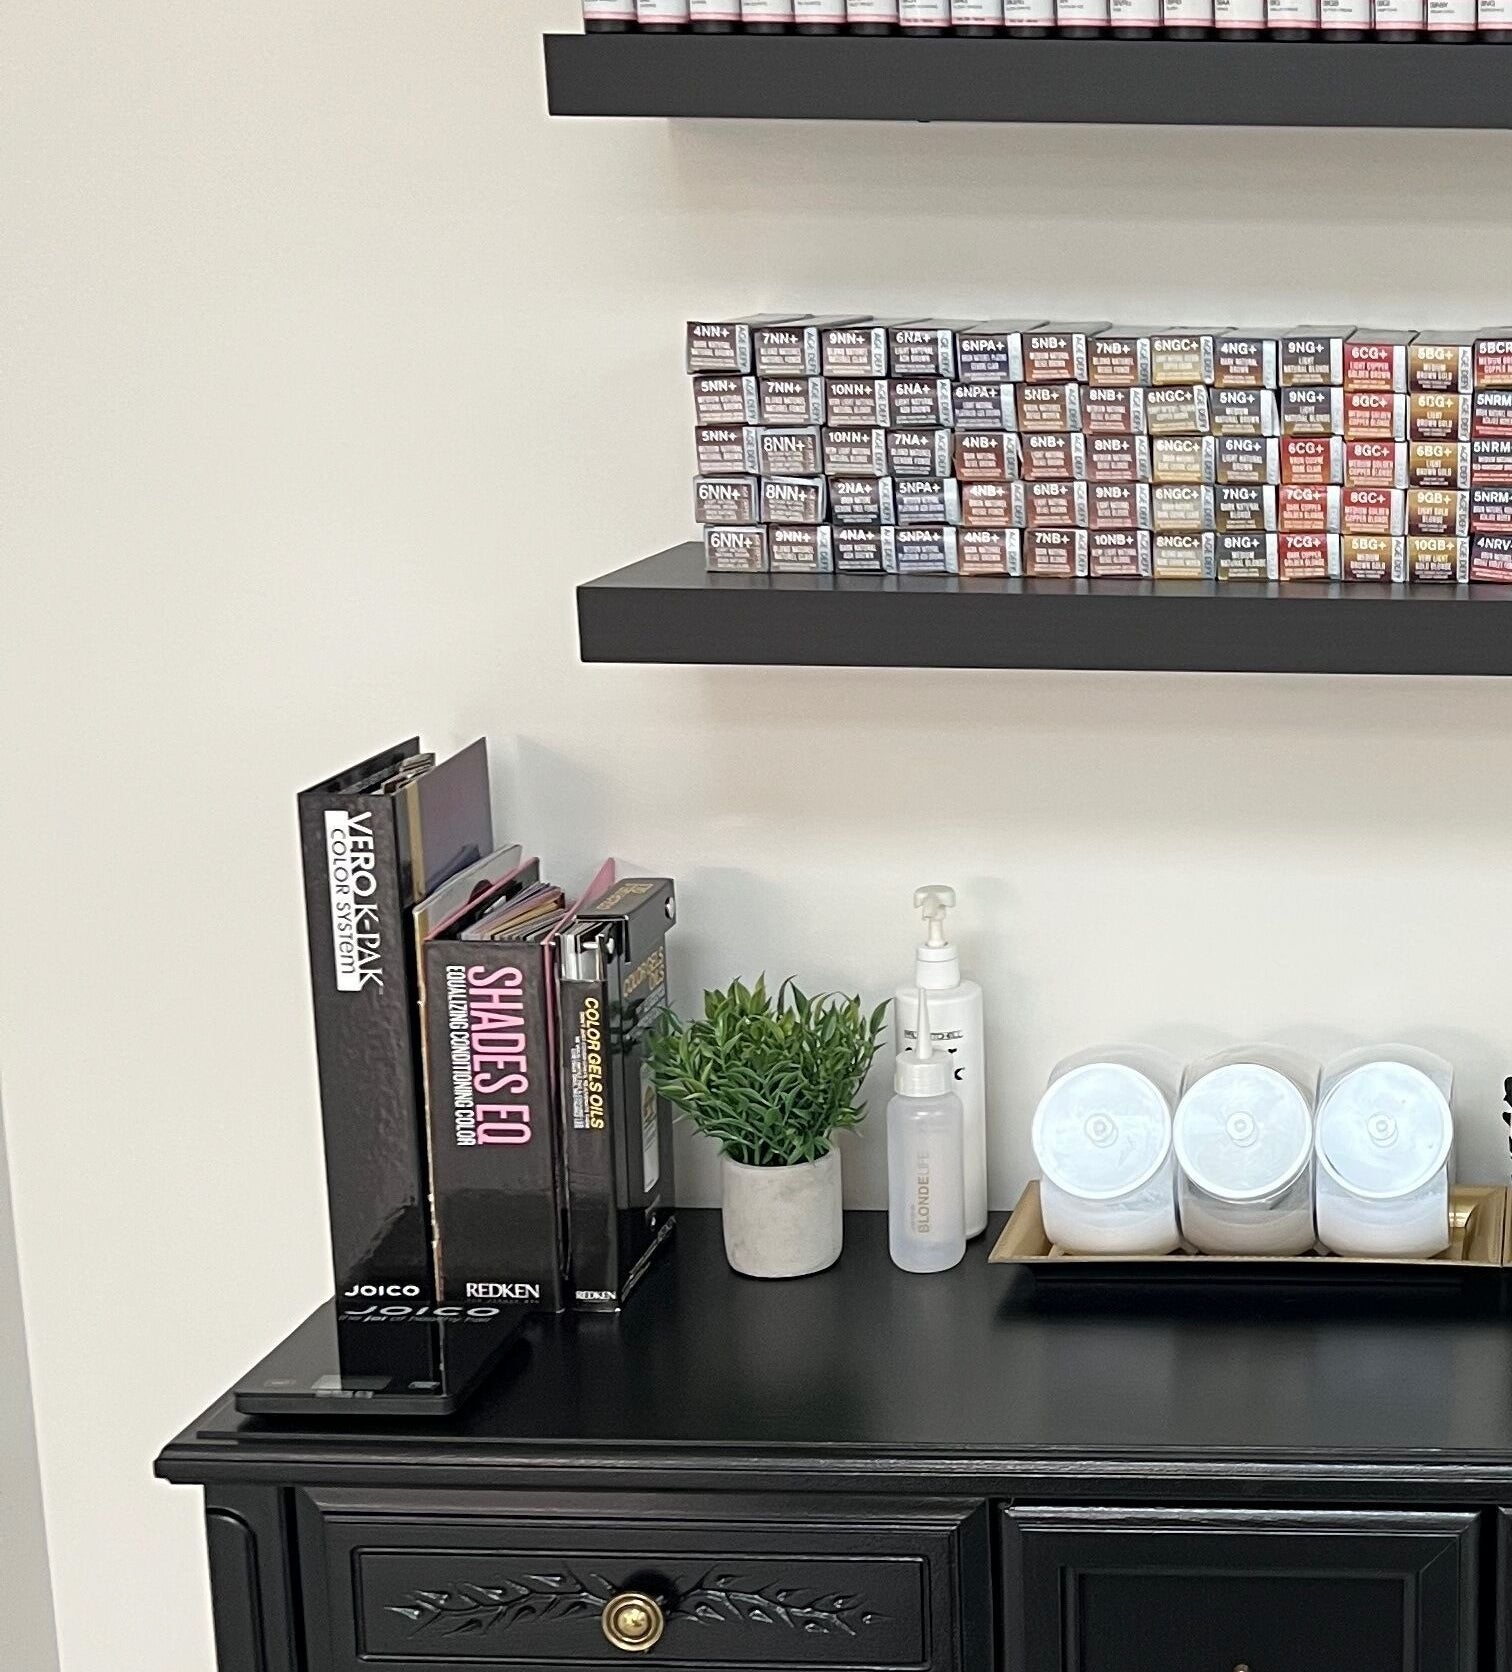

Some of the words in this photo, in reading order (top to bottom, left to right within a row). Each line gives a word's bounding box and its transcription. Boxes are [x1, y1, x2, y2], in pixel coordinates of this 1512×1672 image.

[693, 325, 729, 338] 4NN+
[762, 333, 798, 345] 7NN+
[829, 333, 865, 345] 9NN+
[896, 332, 931, 343] 6NA+
[962, 340, 1005, 351] 6NPA+
[1031, 338, 1066, 349] 5NB+
[1220, 343, 1257, 355] 4NG+
[1288, 342, 1325, 354] 9NG+
[701, 381, 736, 392] 5NN+
[767, 382, 801, 393] 7NN+
[831, 384, 872, 395] 10NN+
[896, 384, 931, 394] 6NA+
[956, 387, 998, 398] 6NPA+
[1024, 390, 1059, 401] 5NB+
[1148, 391, 1193, 402] 6NGC+
[1289, 391, 1325, 402] 9NG+
[701, 431, 737, 442] 5NN+
[829, 432, 870, 443] 10NN+
[894, 434, 929, 445] 7NA+
[764, 437, 804, 451] 8NN+
[962, 438, 998, 449] 4NB+
[1030, 437, 1065, 448] 6NB+
[1225, 440, 1261, 451] 6NG+
[1288, 443, 1324, 454] 6CG+
[699, 484, 741, 499] 6NN+
[838, 482, 872, 494] 2NA+
[1033, 485, 1068, 495] 6NB+
[766, 485, 807, 504] 8NN+
[1223, 488, 1259, 500] 7NG+
[1286, 490, 1321, 500] 7CG+
[711, 533, 752, 548] 6NN+
[839, 530, 874, 541] 4NA+
[1035, 533, 1071, 544] 7NB+
[1094, 535, 1134, 546] 10NB+
[1286, 537, 1322, 548] 7CG+
[347, 811, 377, 897] VERO
[330, 828, 350, 895] COLOR
[354, 904, 384, 986] K-PAK
[446, 965, 469, 1030] EQUALIZING
[585, 997, 601, 1050] COLOR
[467, 965, 529, 1094] SHADES
[449, 1031, 474, 1108] CONDITIONING
[587, 1053, 602, 1092] GELS
[589, 1093, 605, 1129] OILS
[454, 1109, 477, 1146] COLOR
[475, 1104, 532, 1145] EQ
[344, 1285, 420, 1297] JOICO
[466, 1282, 540, 1298] REDKEN
[575, 1290, 616, 1300] REDKEN
[344, 1305, 500, 1317] JOICO
